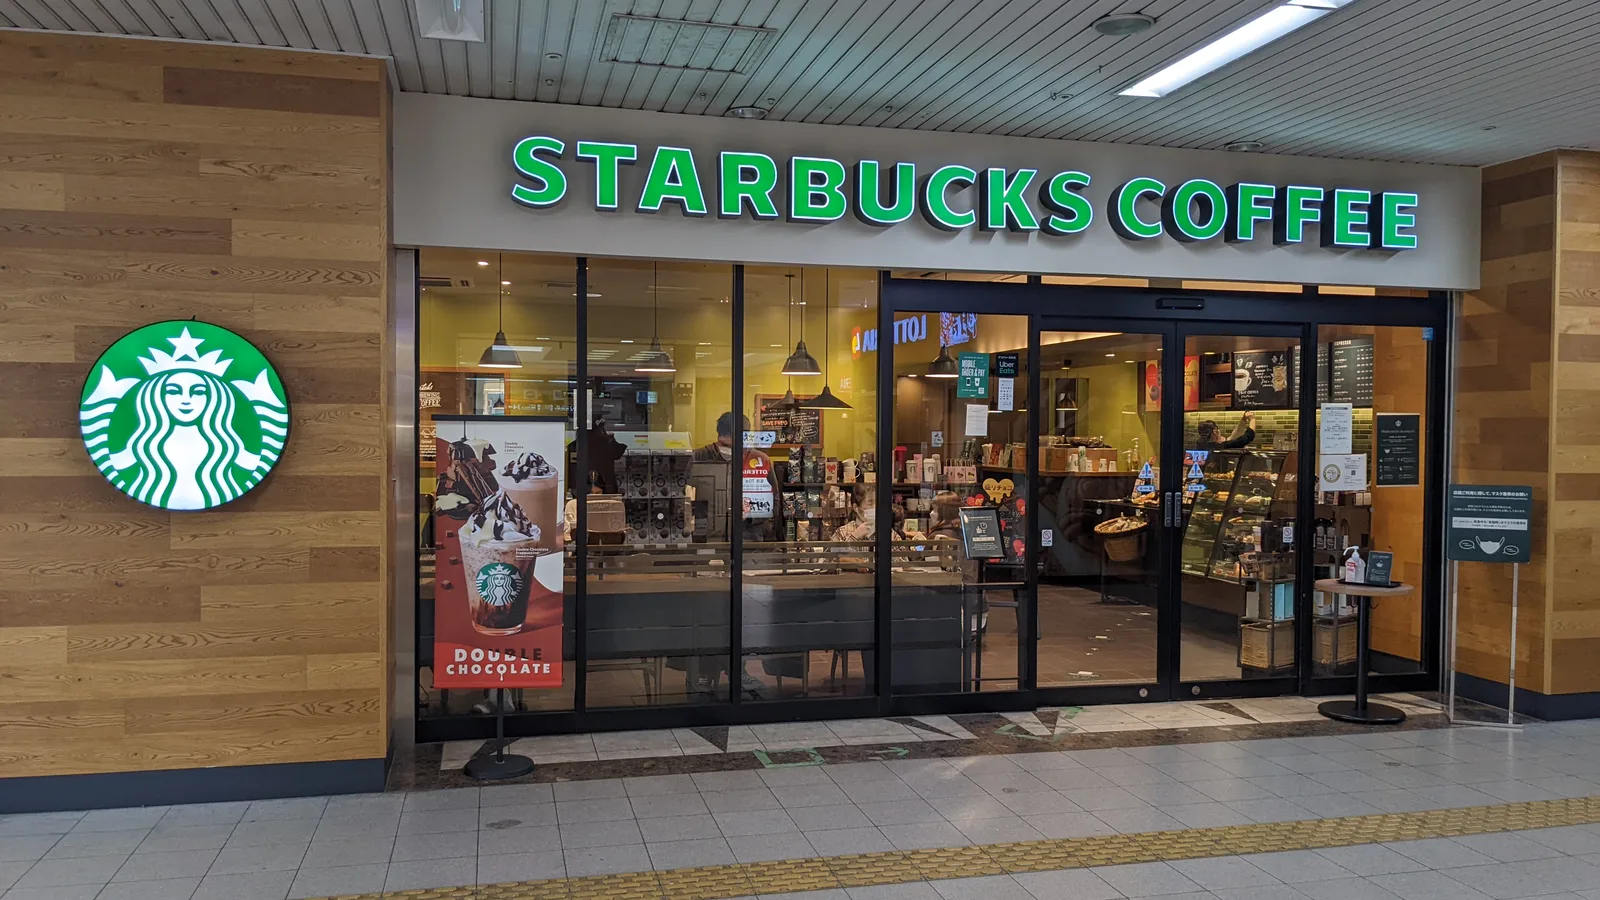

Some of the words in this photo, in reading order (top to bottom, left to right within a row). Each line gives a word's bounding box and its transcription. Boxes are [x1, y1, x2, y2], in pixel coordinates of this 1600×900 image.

[511, 135, 1093, 234] STARBUCKS
[1113, 177, 1418, 249] COFFEE
[454, 648, 542, 662] DOUBLE
[446, 664, 551, 675] CHOCOLATE
